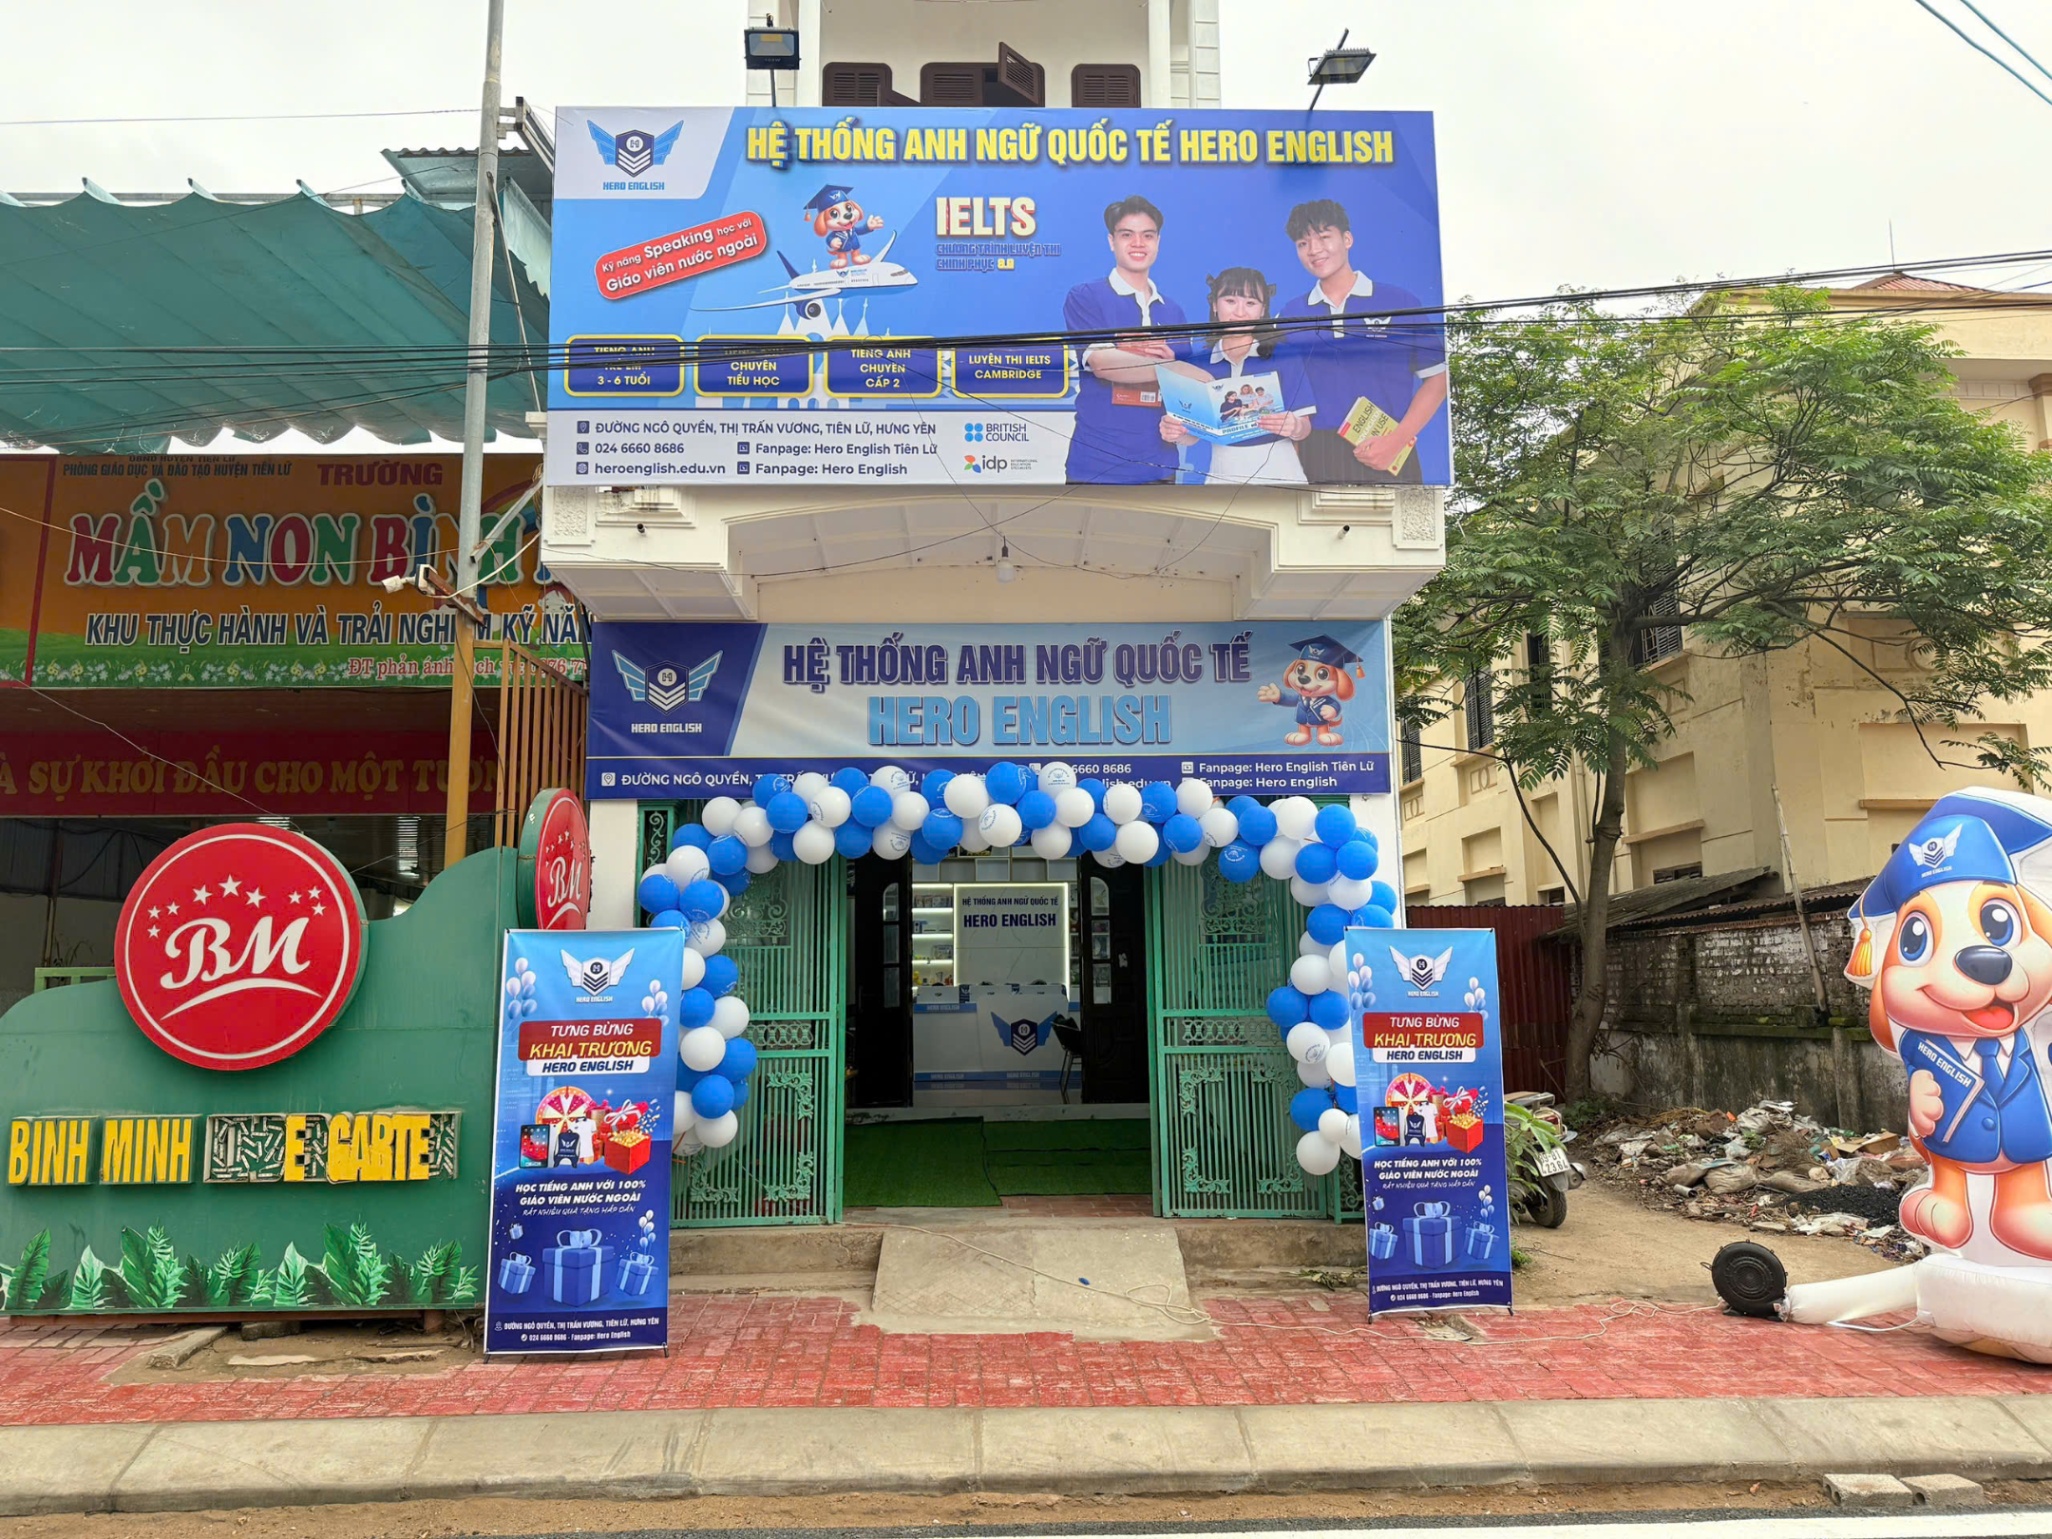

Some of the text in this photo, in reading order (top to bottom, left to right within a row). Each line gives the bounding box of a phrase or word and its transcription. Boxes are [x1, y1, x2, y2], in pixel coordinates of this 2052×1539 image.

[747, 117, 1394, 167] HỆ THỐNG ANH NGỮ QUỐC TẾ HERO ENGLISH
[603, 181, 665, 191] HERO ENGLISH
[936, 196, 1036, 237] IELTS
[616, 254, 642, 268] năng
[644, 228, 714, 259] Speaking
[716, 224, 735, 237] học
[736, 218, 752, 230] với
[606, 234, 758, 292] Giáo viên nước ngoài
[731, 360, 777, 371] CHUYÊN
[969, 352, 1050, 367] LUYỆN THI IELTS
[597, 371, 651, 386] 3 6 TUỔI
[727, 372, 780, 388] TIỂU HỌC
[865, 375, 900, 388] CẤP 2
[974, 369, 1042, 380] CAMBRIDGE
[1352, 402, 1376, 433] ENGLISH
[1378, 413, 1389, 429] USE
[595, 420, 639, 434] ĐƯỜNG
[643, 420, 669, 434] NGÔ
[720, 423, 739, 436] THỊ
[742, 419, 775, 434] TRẤN
[777, 421, 823, 436] VƯƠNG,
[826, 421, 851, 434] TIÊN
[876, 422, 910, 434] HƯNG
[912, 421, 936, 434] YÊN
[986, 423, 1026, 433] BRITISH
[986, 432, 1029, 442] COUNCIL
[595, 443, 685, 454] 024 6660 8686
[755, 443, 811, 456] Fanpage:
[814, 443, 843, 454] Hero
[846, 443, 890, 457] English
[893, 443, 919, 454] Tiên
[63, 462, 98, 476] PHÒNG
[101, 462, 124, 476] GIÁO
[127, 464, 148, 479] DỤC
[152, 462, 163, 476] VÀ
[192, 464, 210, 479] TẠO
[214, 462, 248, 479] HUYỆN
[595, 463, 726, 476] heroenglish.edu.vn
[755, 463, 907, 476] Fanpage: Hero English
[982, 455, 1008, 473] idp
[317, 459, 443, 486] TRƯỜNG
[64, 478, 360, 585] MẦM NON
[85, 600, 538, 654] KHU THỰC HÀNH VÀ TRẢI KỸ
[348, 658, 374, 676] ĐT
[376, 653, 419, 681] phản
[783, 630, 1253, 693] HỆ THỐNG ANH NGỮ QUỐC TẾ
[867, 695, 1172, 746] HERO ENGLISH
[631, 723, 702, 734] HERO ENGLISH
[28, 754, 81, 802] SỰ
[173, 745, 248, 794] ĐẦU
[254, 761, 324, 794] CHO
[330, 751, 404, 801] MỘT
[1103, 763, 1131, 774] 8686
[1199, 763, 1252, 774] Fanpage:
[1255, 762, 1283, 773] Hero
[1286, 761, 1328, 774] English
[1331, 761, 1356, 771] Tiên
[621, 772, 702, 785] ĐƯỜNG NGÔ
[1256, 776, 1337, 789] Hero English
[547, 856, 583, 908] BM
[963, 913, 1056, 927] HERO ENGLISH
[160, 916, 310, 989] BM
[1389, 1014, 1460, 1028] TƯNG BỪNG
[551, 1021, 634, 1037] TƯNG BỪNG
[1374, 1032, 1477, 1047] KHAI TRƯƠNG
[530, 1040, 653, 1058] KHAI TRƯƠNG
[1387, 1050, 1463, 1060] HERO ENGLISH
[542, 1060, 634, 1073] HERO ENGLISH
[1917, 1041, 1972, 1088] HERO ENGLISH
[8, 1120, 90, 1184] BINH
[102, 1118, 192, 1183] MINH
[515, 1179, 646, 1194] HỌC TIẾNG ANH VỚI 100%
[520, 1192, 641, 1205] GIÁO VIÊN NƯỚC NGOÀI
